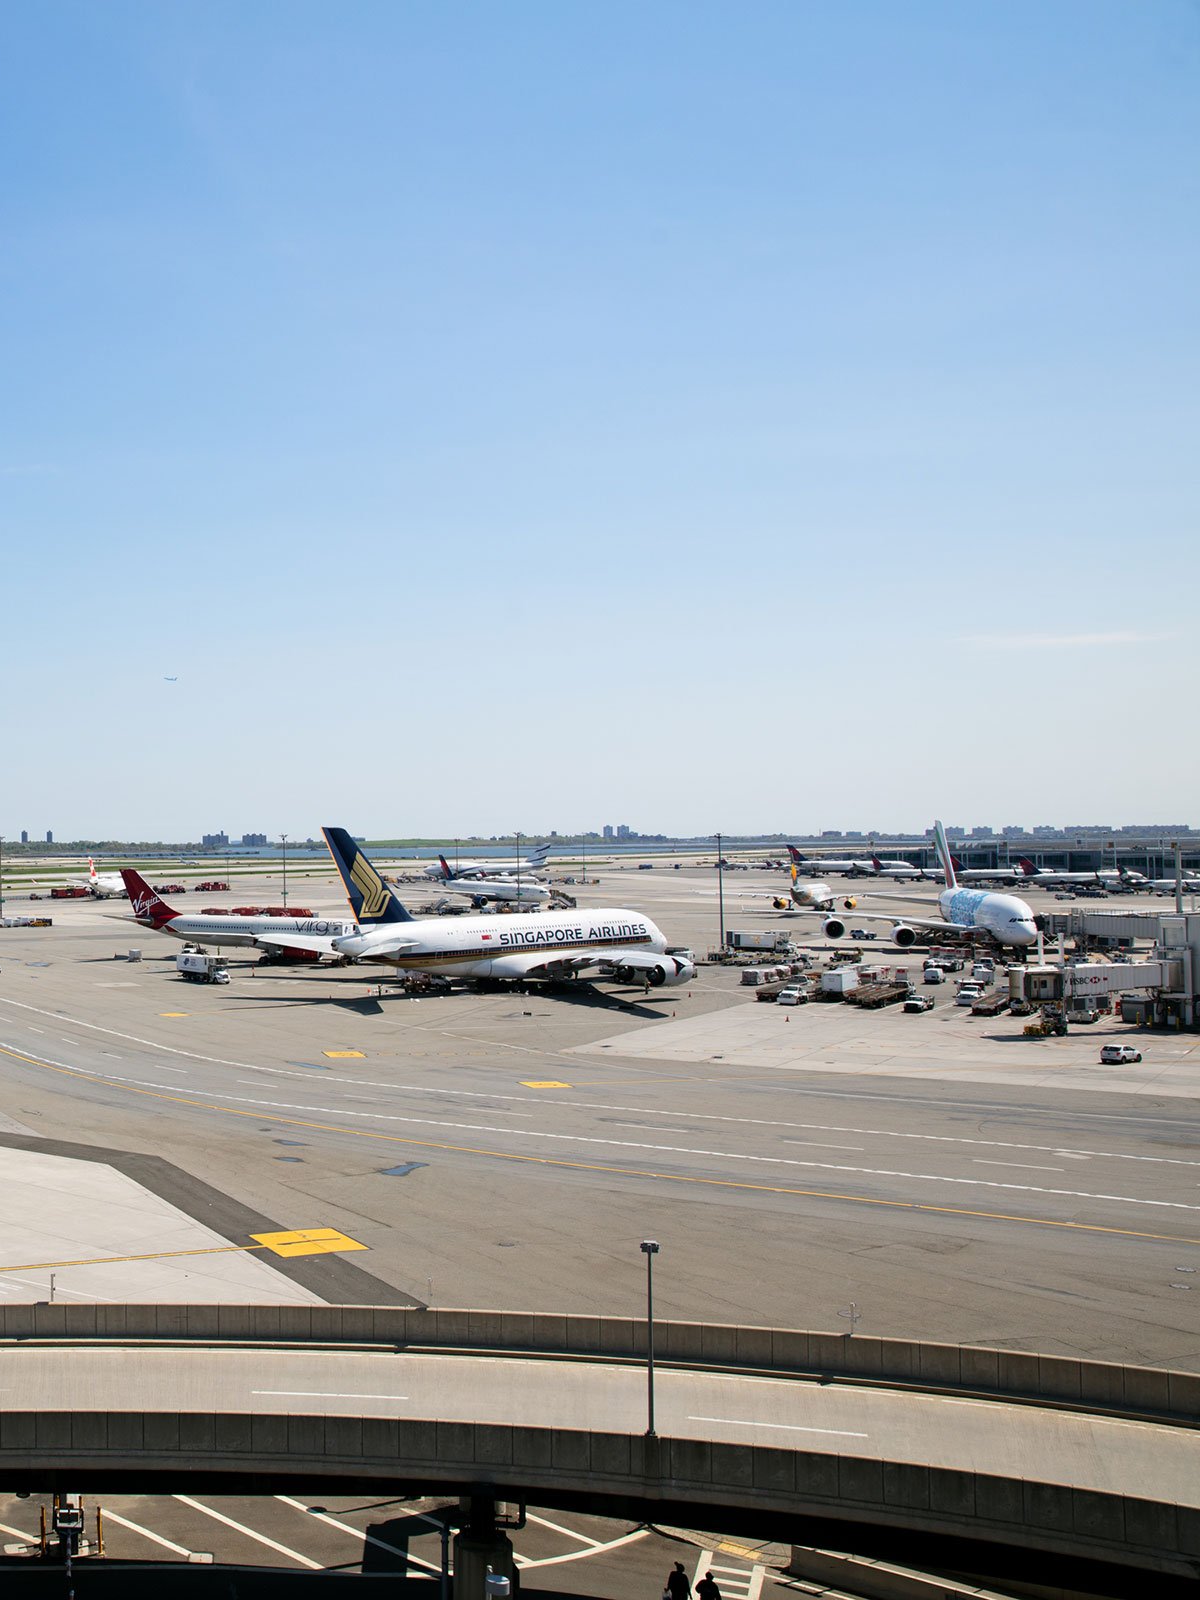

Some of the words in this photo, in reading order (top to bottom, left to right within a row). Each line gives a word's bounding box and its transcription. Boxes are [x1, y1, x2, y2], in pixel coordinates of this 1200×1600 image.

[132, 891, 160, 916] Virgin
[499, 928, 584, 946] SINGAPORE
[588, 923, 647, 938] AIRLINES
